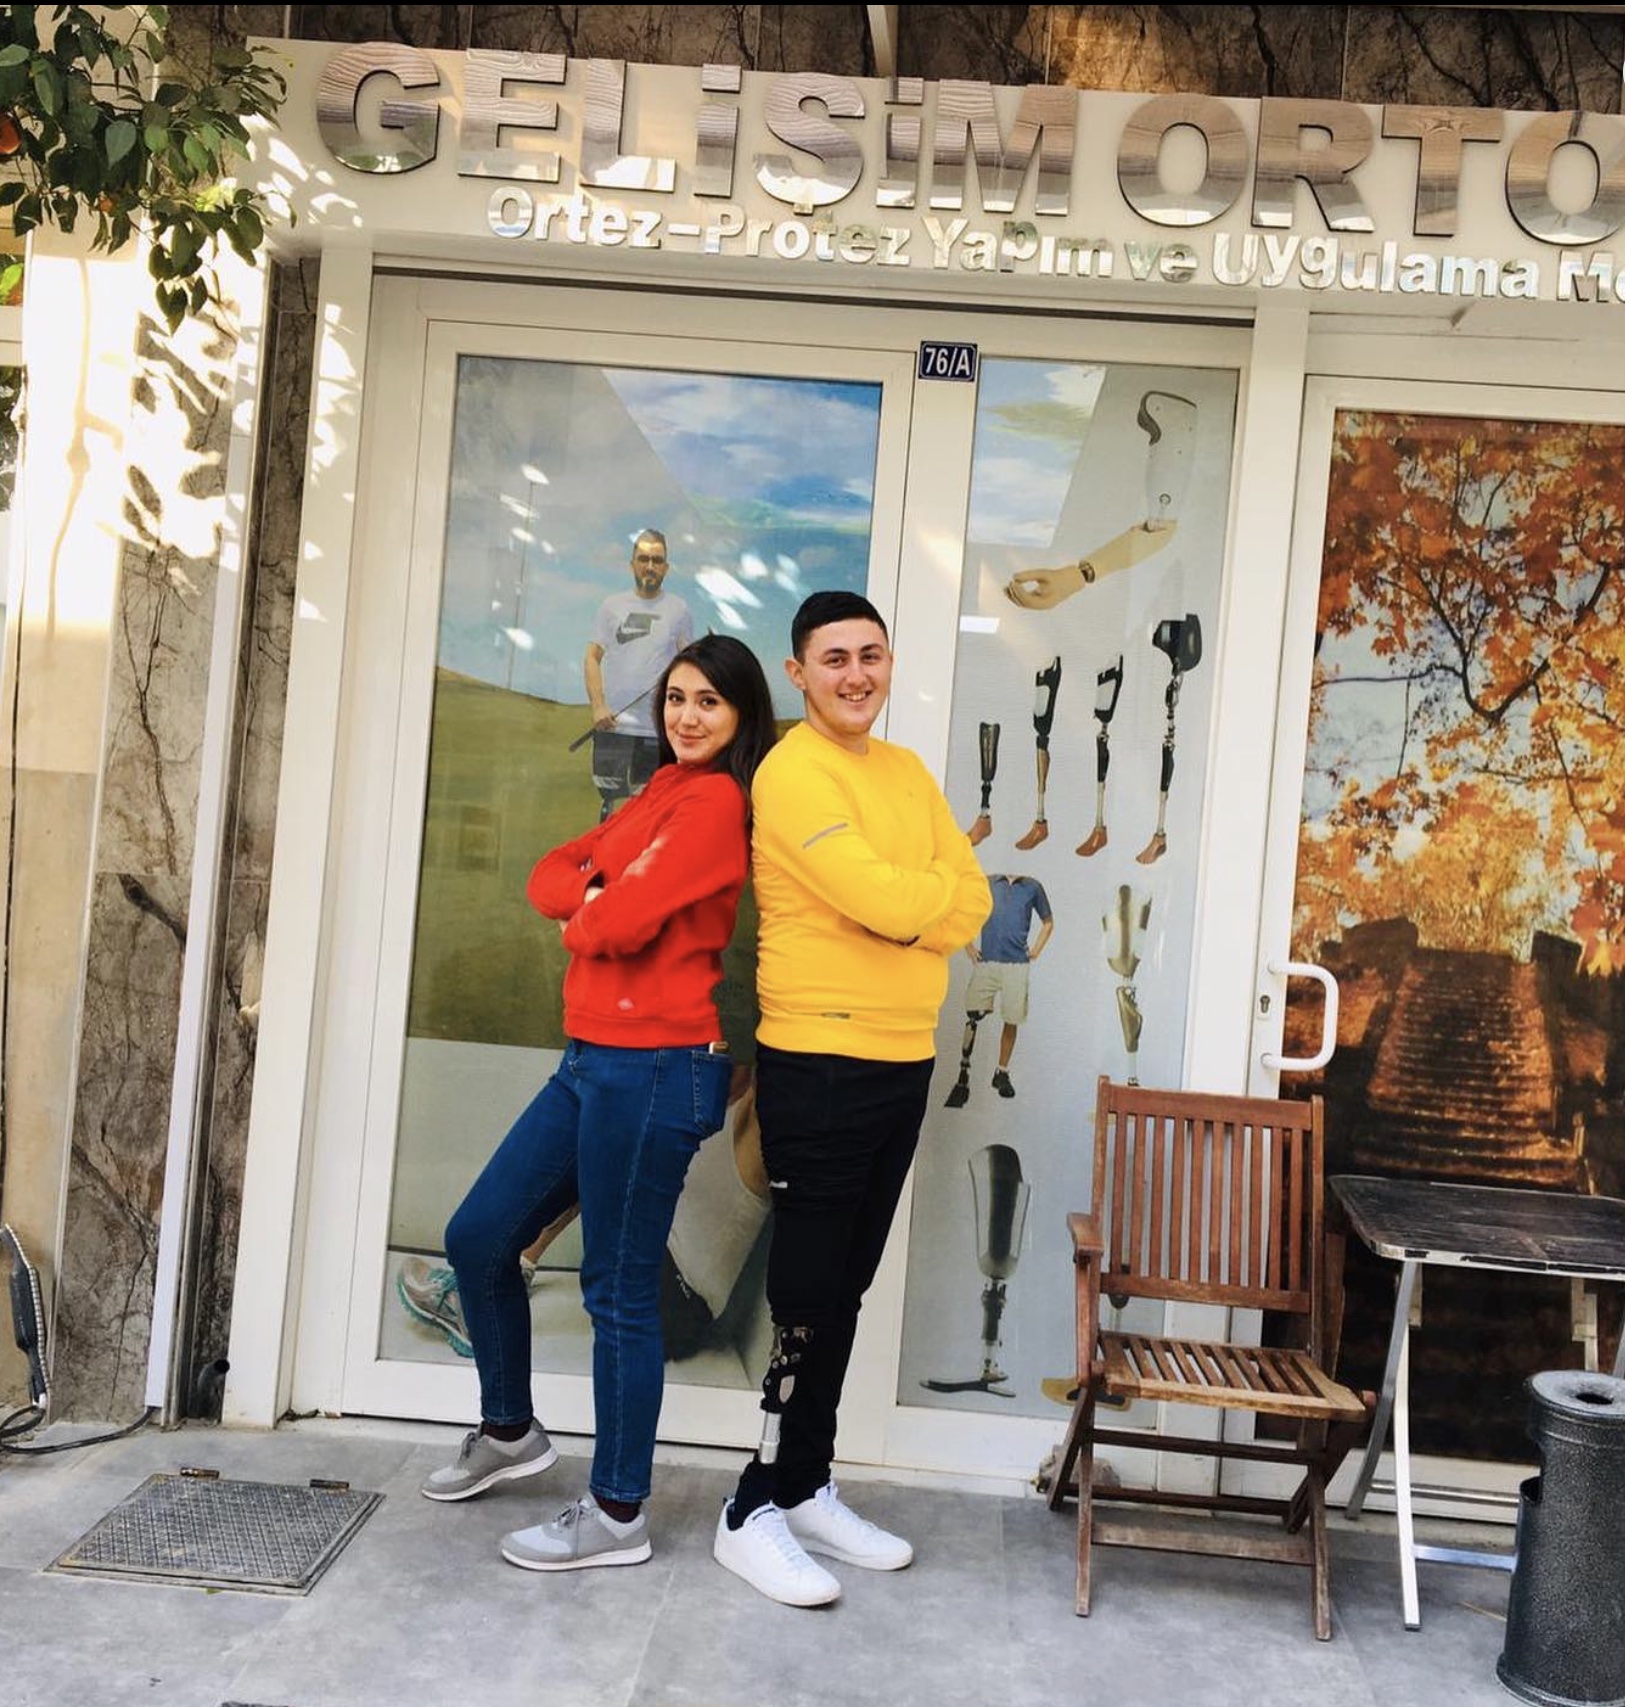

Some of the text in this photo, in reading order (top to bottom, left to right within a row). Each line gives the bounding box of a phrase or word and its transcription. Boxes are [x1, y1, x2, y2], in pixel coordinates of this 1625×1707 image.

[922, 216, 1114, 279] Yapım
[1123, 238, 1199, 283] ve
[1212, 231, 1540, 299] Uygulama
[1555, 249, 1625, 304] M
[925, 346, 971, 377] 76/A
